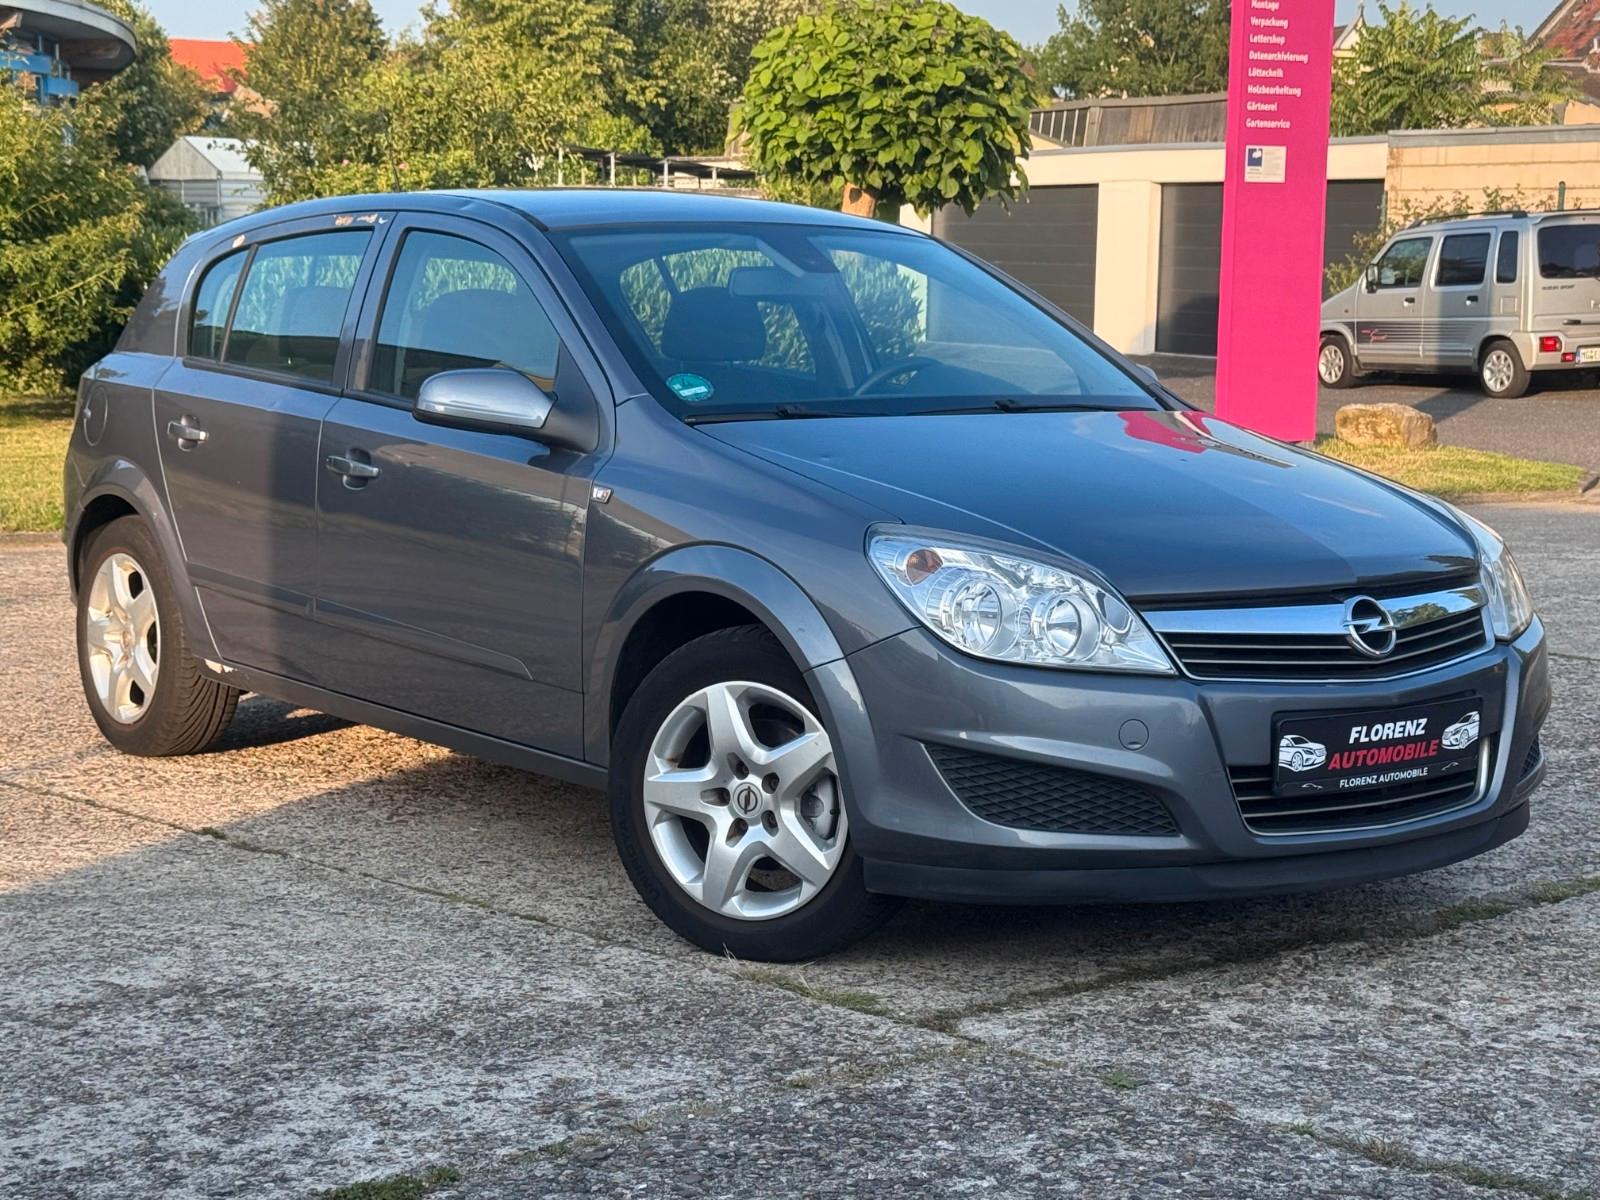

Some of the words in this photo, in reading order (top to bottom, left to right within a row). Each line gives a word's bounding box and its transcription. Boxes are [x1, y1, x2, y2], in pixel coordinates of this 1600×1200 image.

[1251, 0, 1279, 12] Montage
[1250, 16, 1289, 29] Verpackung
[1249, 33, 1285, 45] Lettershop
[1248, 50, 1309, 64] Datenarchivierung
[1248, 67, 1284, 78] Löttechnik
[1247, 84, 1302, 97] Holzbearbeitung
[1247, 101, 1278, 112] Gärtnerei
[1246, 118, 1291, 129] Gartenservice
[1348, 718, 1428, 744] FLORENZ
[1327, 739, 1440, 770] AUTOMOBILE
[1339, 775, 1378, 789] FLORENZ
[1379, 767, 1429, 784] AUTOMOBILE
